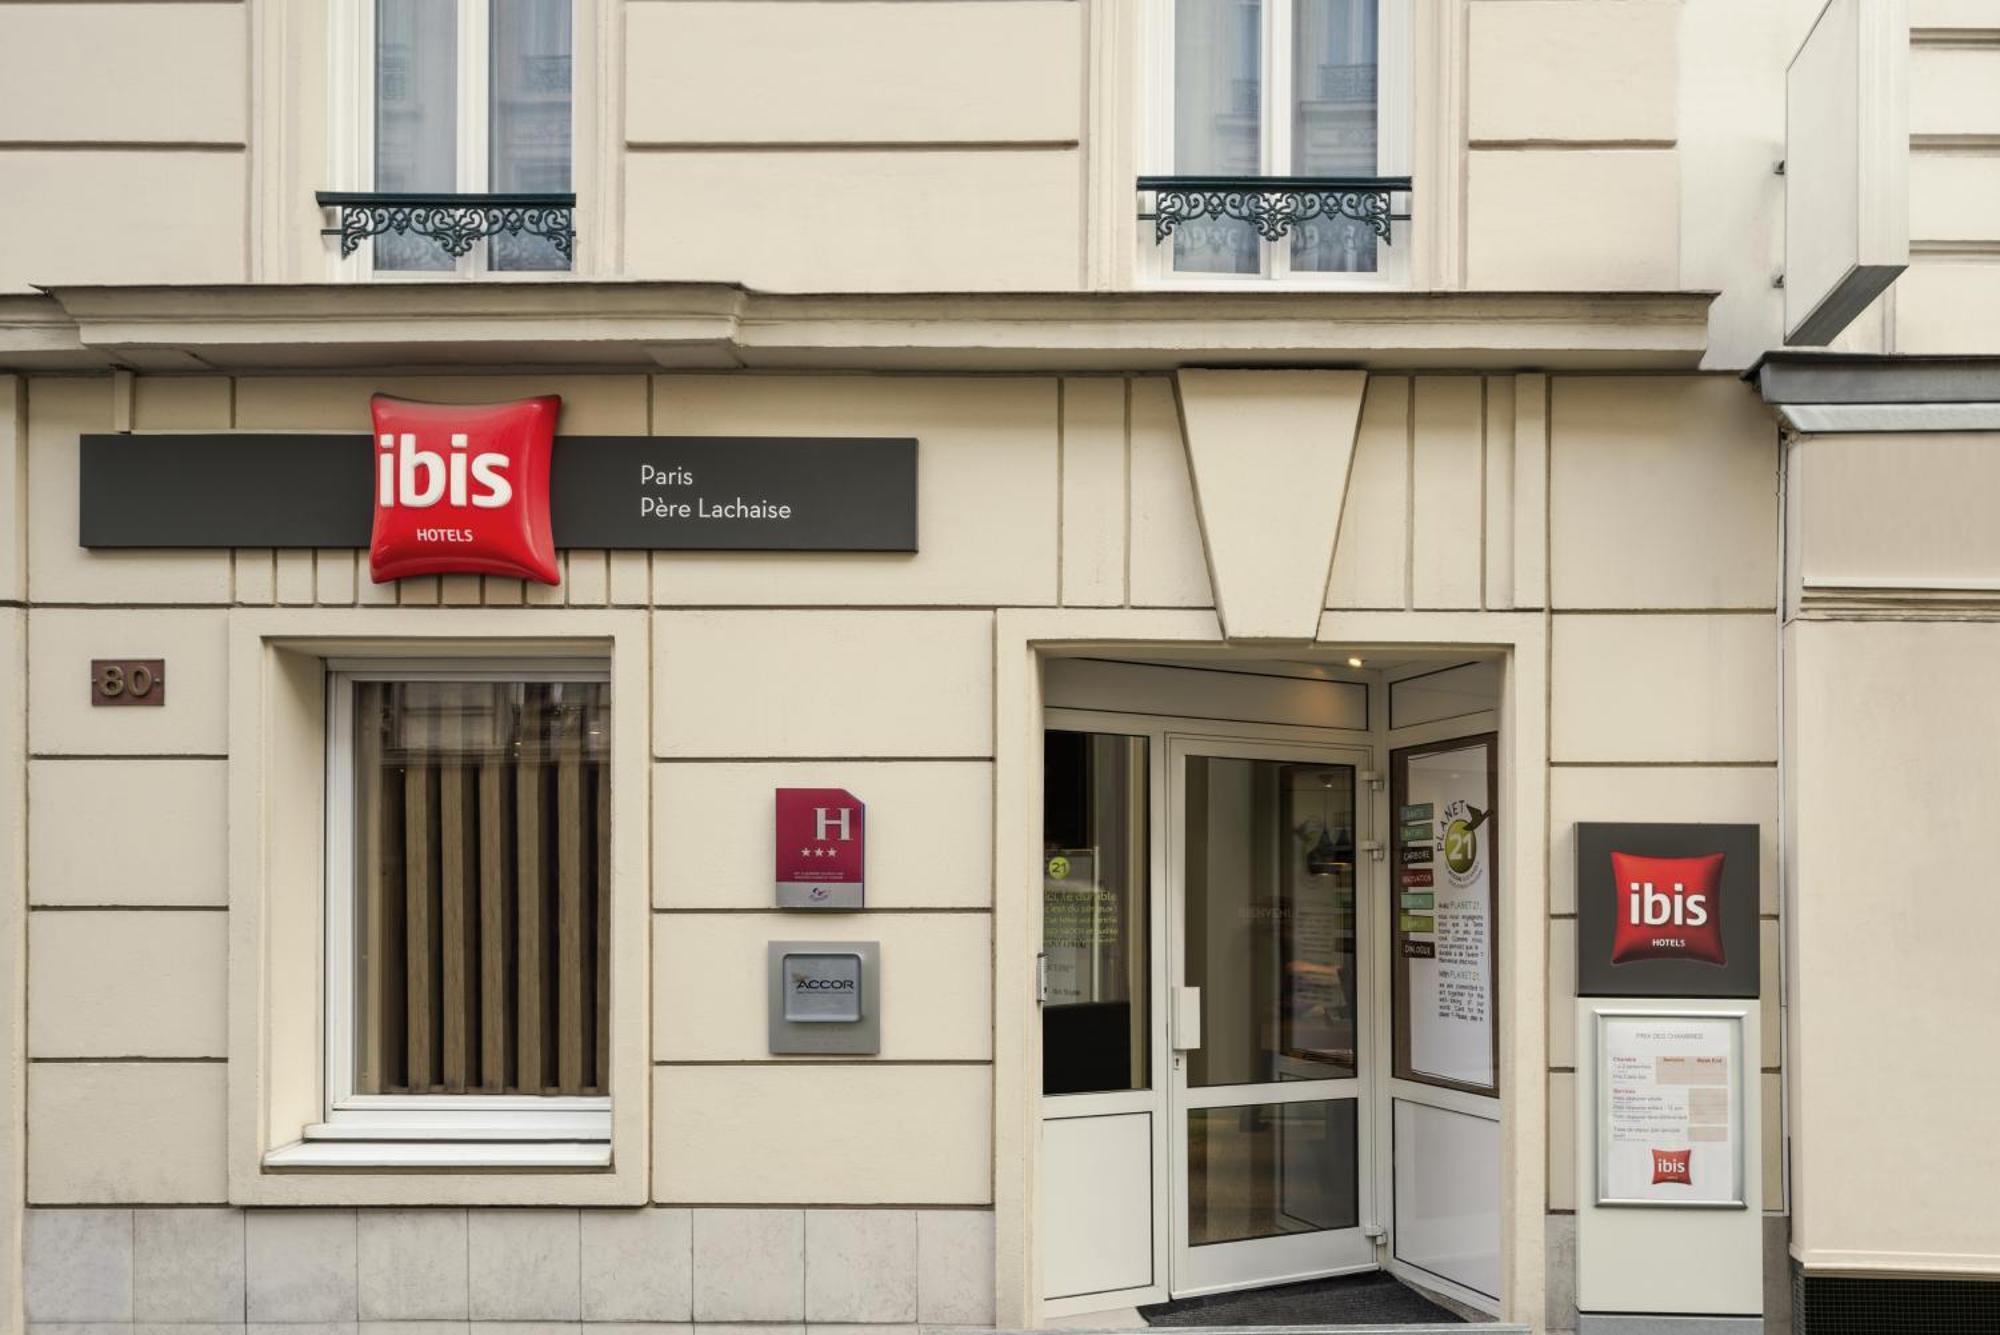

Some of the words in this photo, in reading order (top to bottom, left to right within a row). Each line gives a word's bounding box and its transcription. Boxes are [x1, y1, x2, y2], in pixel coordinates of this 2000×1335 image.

[380, 434, 512, 507] ibis
[641, 465, 694, 485] Paris
[641, 497, 692, 518] Père
[699, 497, 792, 518] Lachaise
[417, 528, 473, 542] HOTELS
[98, 665, 152, 696] 80
[813, 808, 853, 840] H
[1437, 800, 1465, 852] PLANET
[1449, 833, 1474, 861] 21
[1051, 862, 1067, 873] 21
[1630, 882, 1708, 926] ibis
[1652, 939, 1686, 947] HOTELS
[797, 979, 855, 990] ACCOR
[1658, 1158, 1685, 1173] ibis
